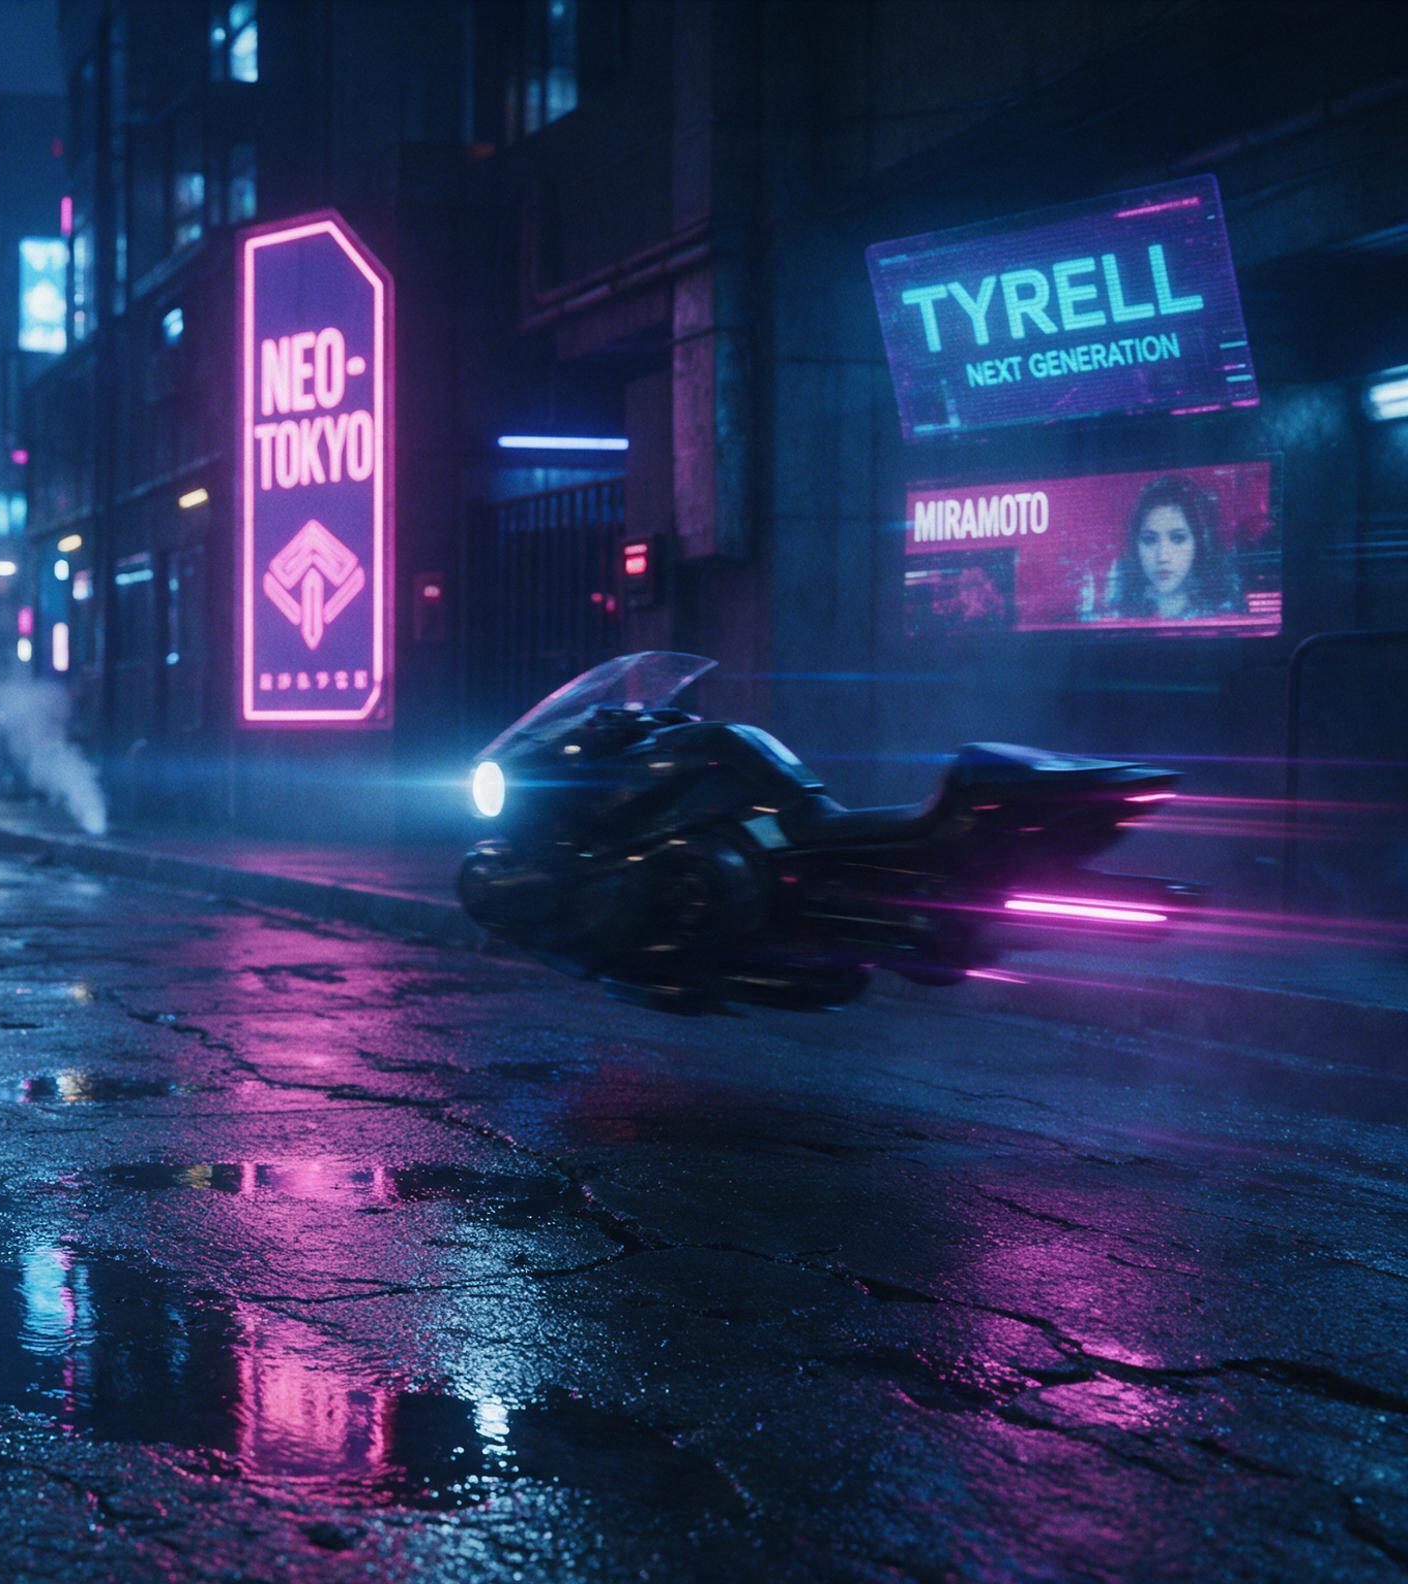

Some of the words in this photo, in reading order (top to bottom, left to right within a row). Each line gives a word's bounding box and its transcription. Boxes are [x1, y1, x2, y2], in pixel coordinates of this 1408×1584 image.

[901, 244, 1204, 353] TYRELL
[965, 356, 1022, 388] NEXT
[1028, 332, 1181, 379] GENERATION
[254, 409, 374, 491] TOKYO
[914, 491, 1049, 543] MIRAMOTO
